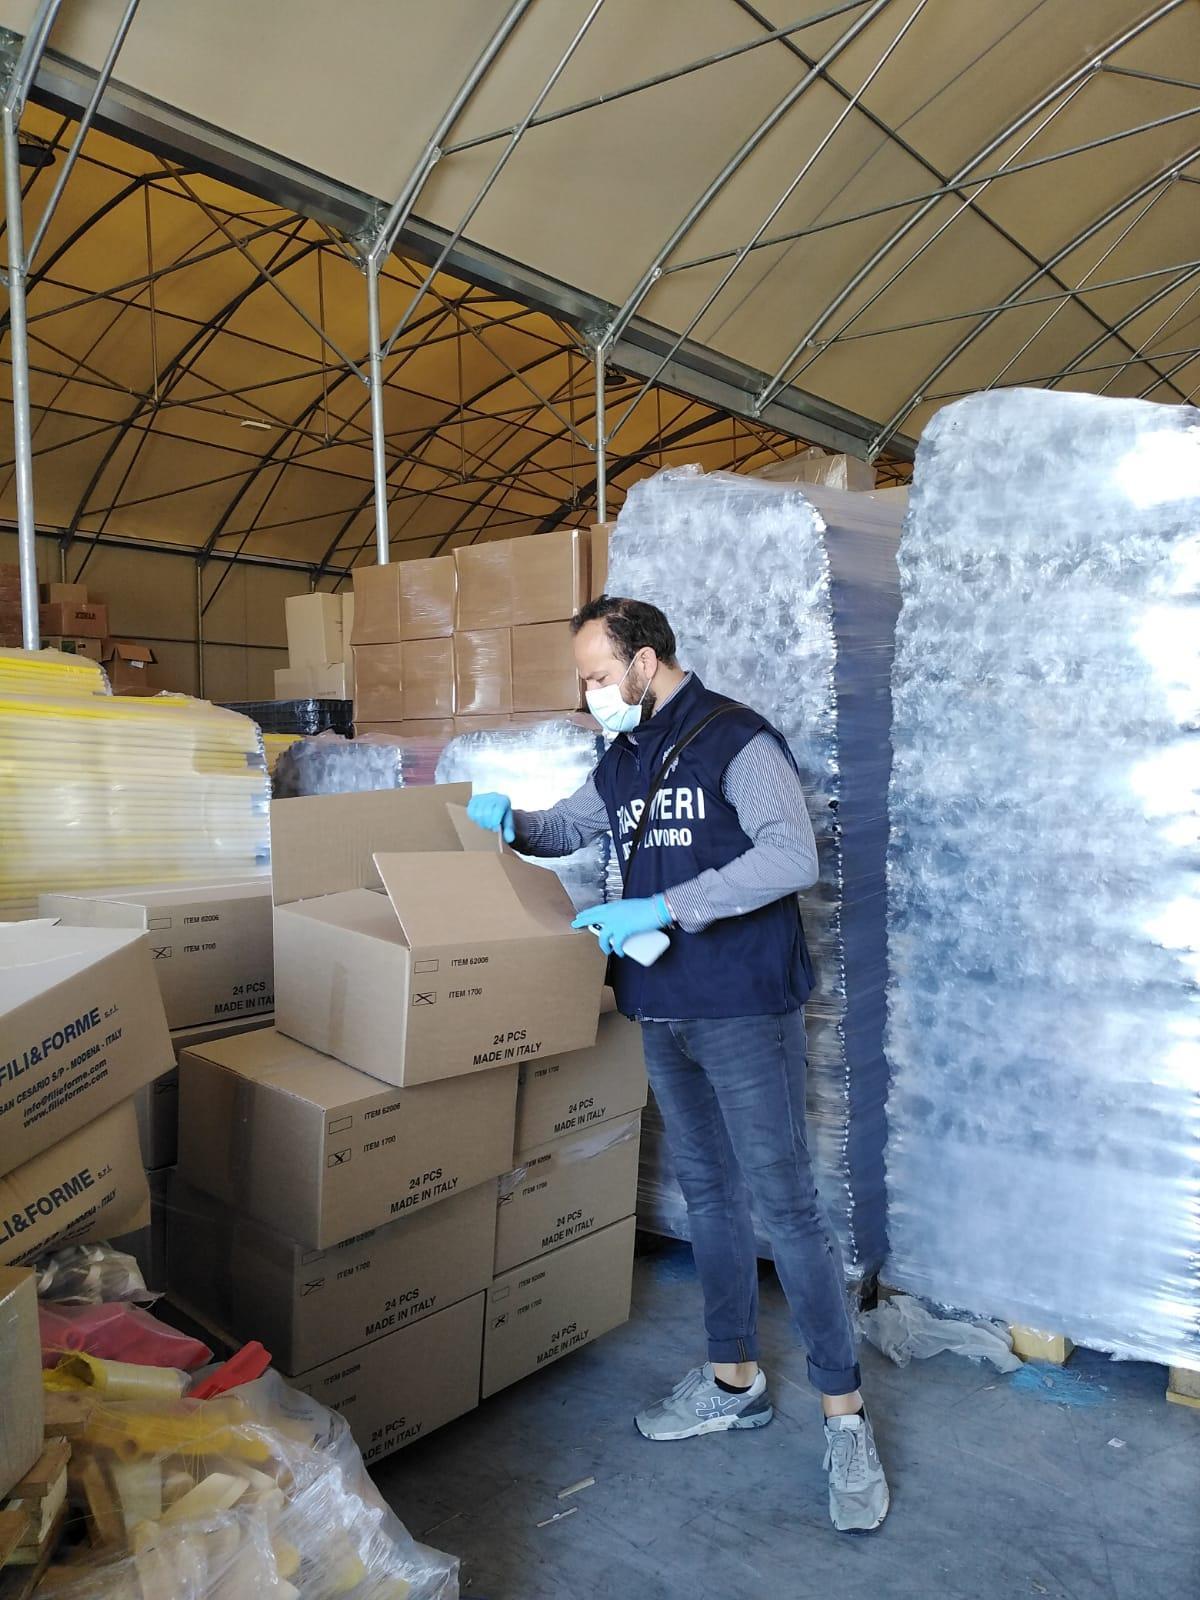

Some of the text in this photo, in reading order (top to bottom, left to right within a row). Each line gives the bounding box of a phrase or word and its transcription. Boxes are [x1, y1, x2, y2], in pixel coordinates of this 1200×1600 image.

[644, 828, 692, 848] LAVORO
[183, 916, 200, 925] ITEM
[183, 942, 217, 953] ITEM 1700
[451, 958, 468, 967] ITEM
[232, 982, 267, 996] 24 PCS
[449, 987, 483, 999] ITEM 1700
[214, 1000, 243, 1015] MADE
[245, 998, 256, 1009] IN
[493, 1030, 527, 1045] 24 PCS
[472, 1042, 542, 1066] MADE IN ITALY
[17, 1076, 50, 1104] CESARIO
[51, 1067, 65, 1082] S/P
[70, 1044, 101, 1070] MODENA
[105, 1027, 122, 1047] ITALY
[364, 1108, 381, 1121] ITEM
[568, 1098, 594, 1114] 24 PCS
[553, 1107, 606, 1133] MADE IN ITALY
[363, 1135, 396, 1153] ITEM 1700
[409, 1168, 443, 1190] 24 PCS
[390, 1177, 458, 1214] MADE IN ITALY
[522, 1185, 535, 1196] ITEM
[556, 1209, 582, 1227] 24 PCS
[541, 1217, 594, 1248] MADE IN ITALY
[337, 1267, 354, 1280] ITEM
[518, 1277, 531, 1289] ITEM
[385, 1288, 420, 1312] 24 PCS
[365, 1295, 436, 1336] MADE IN ITALY
[517, 1304, 530, 1316] ITEM
[551, 1322, 577, 1343] 24 PCS
[536, 1329, 589, 1364] MADE IN ITALY
[371, 1416, 406, 1442] 24 PCS
[362, 1421, 422, 1460] ADE IN ITALY
